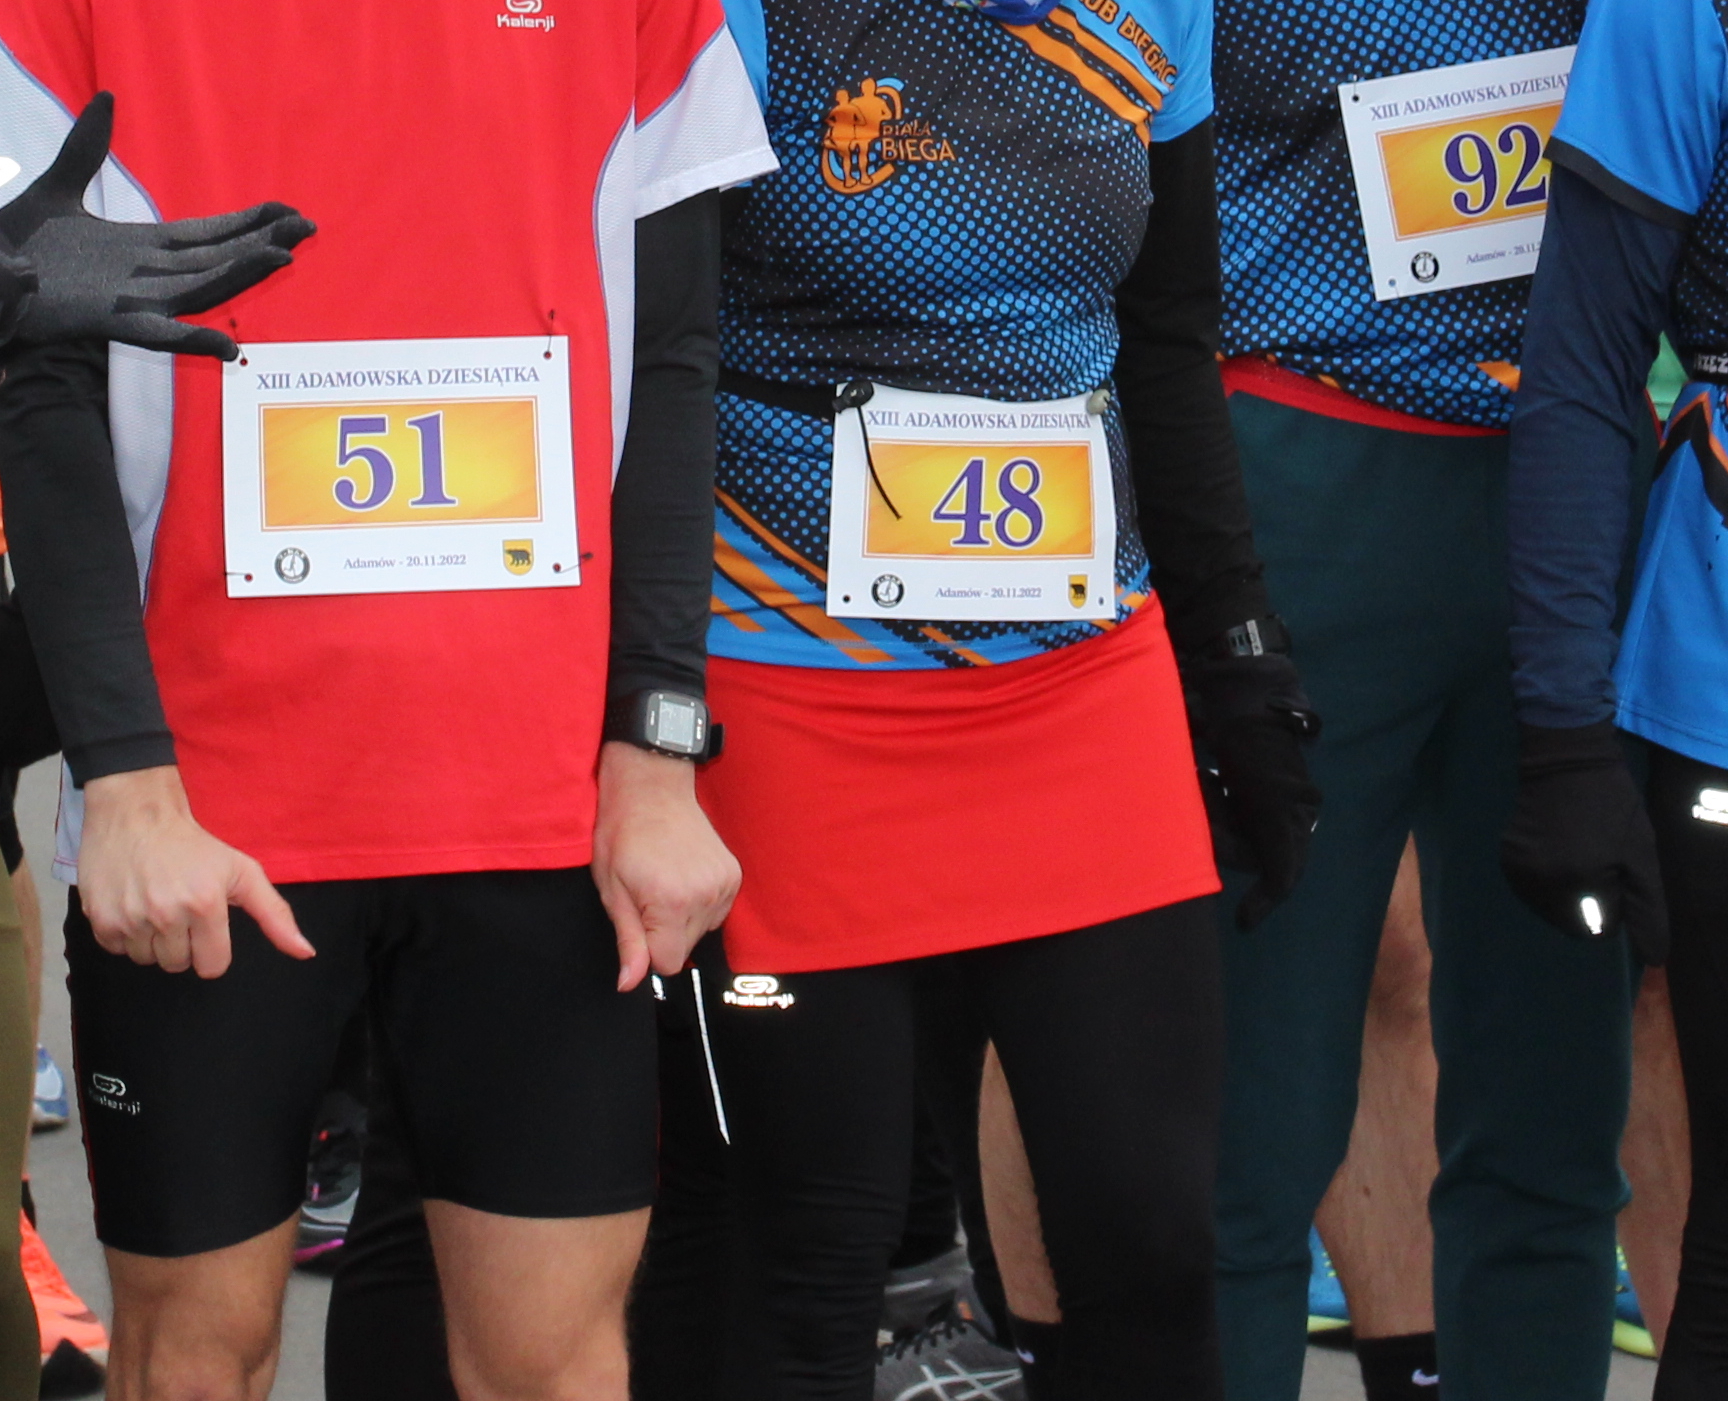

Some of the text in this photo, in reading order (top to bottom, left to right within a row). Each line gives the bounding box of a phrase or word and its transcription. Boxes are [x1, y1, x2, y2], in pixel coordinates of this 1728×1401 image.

[496, 13, 555, 33] Kalenji
[1117, 11, 1177, 91] BIEGAC
[1370, 73, 1570, 121] XIII ADAMOWSKA DZIESIĄT
[882, 137, 956, 161] BIEGA
[1443, 123, 1548, 217] 92
[257, 365, 540, 390] XIII ADAMOWSKA DZIESIĄTKA
[866, 409, 1092, 432] XIII ADAMOWSKA DZIESIĄTKA
[333, 411, 458, 511] 51
[932, 457, 1045, 549] 48
[343, 555, 396, 570] Adamów
[406, 554, 467, 568] 20.11.2022
[935, 587, 982, 599] Adamów
[991, 587, 1042, 599] 20.11.2022
